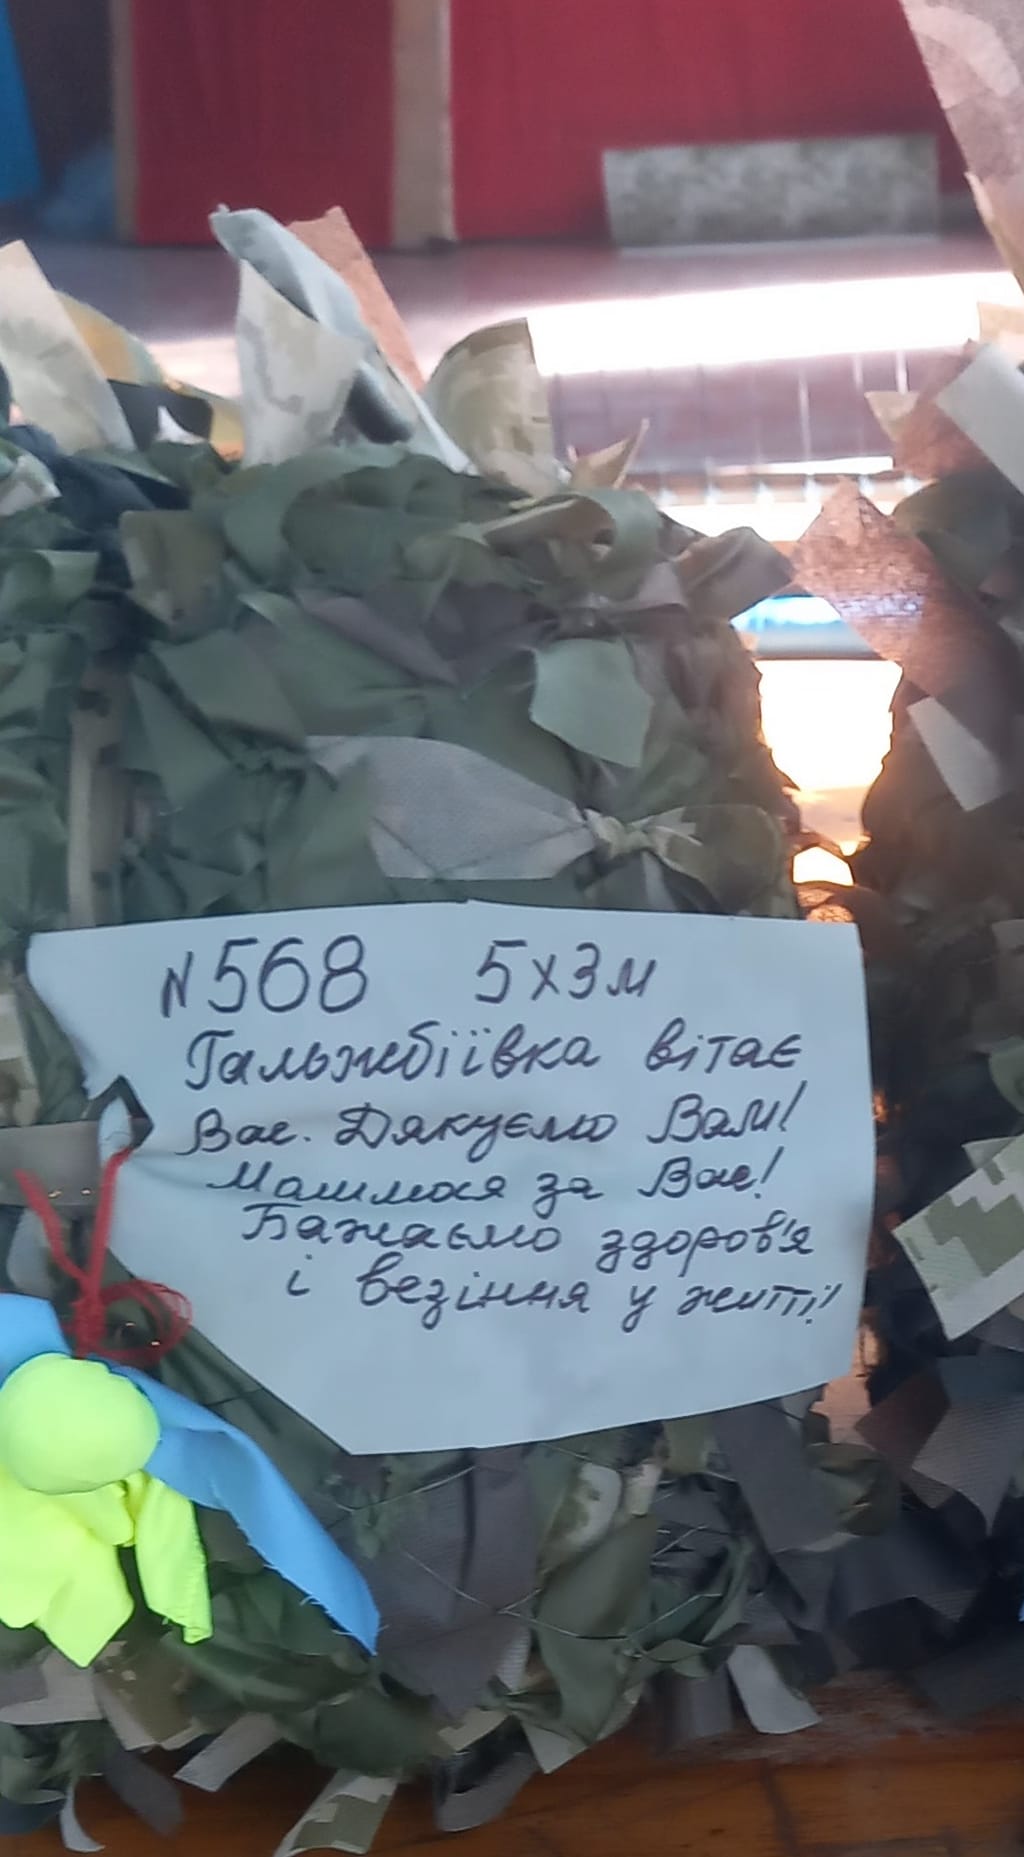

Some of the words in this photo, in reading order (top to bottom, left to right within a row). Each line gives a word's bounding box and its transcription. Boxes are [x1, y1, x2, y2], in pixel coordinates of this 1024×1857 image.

[645, 1016, 803, 1074] вітає
[333, 1101, 618, 1164] Дякуємо
[645, 1078, 808, 1144] Вам!
[531, 1172, 605, 1220] за
[636, 1145, 785, 1199] Вас!
[240, 1201, 562, 1252] Бажаємо
[355, 1250, 591, 1331] везіння
[620, 1284, 658, 1333] у
